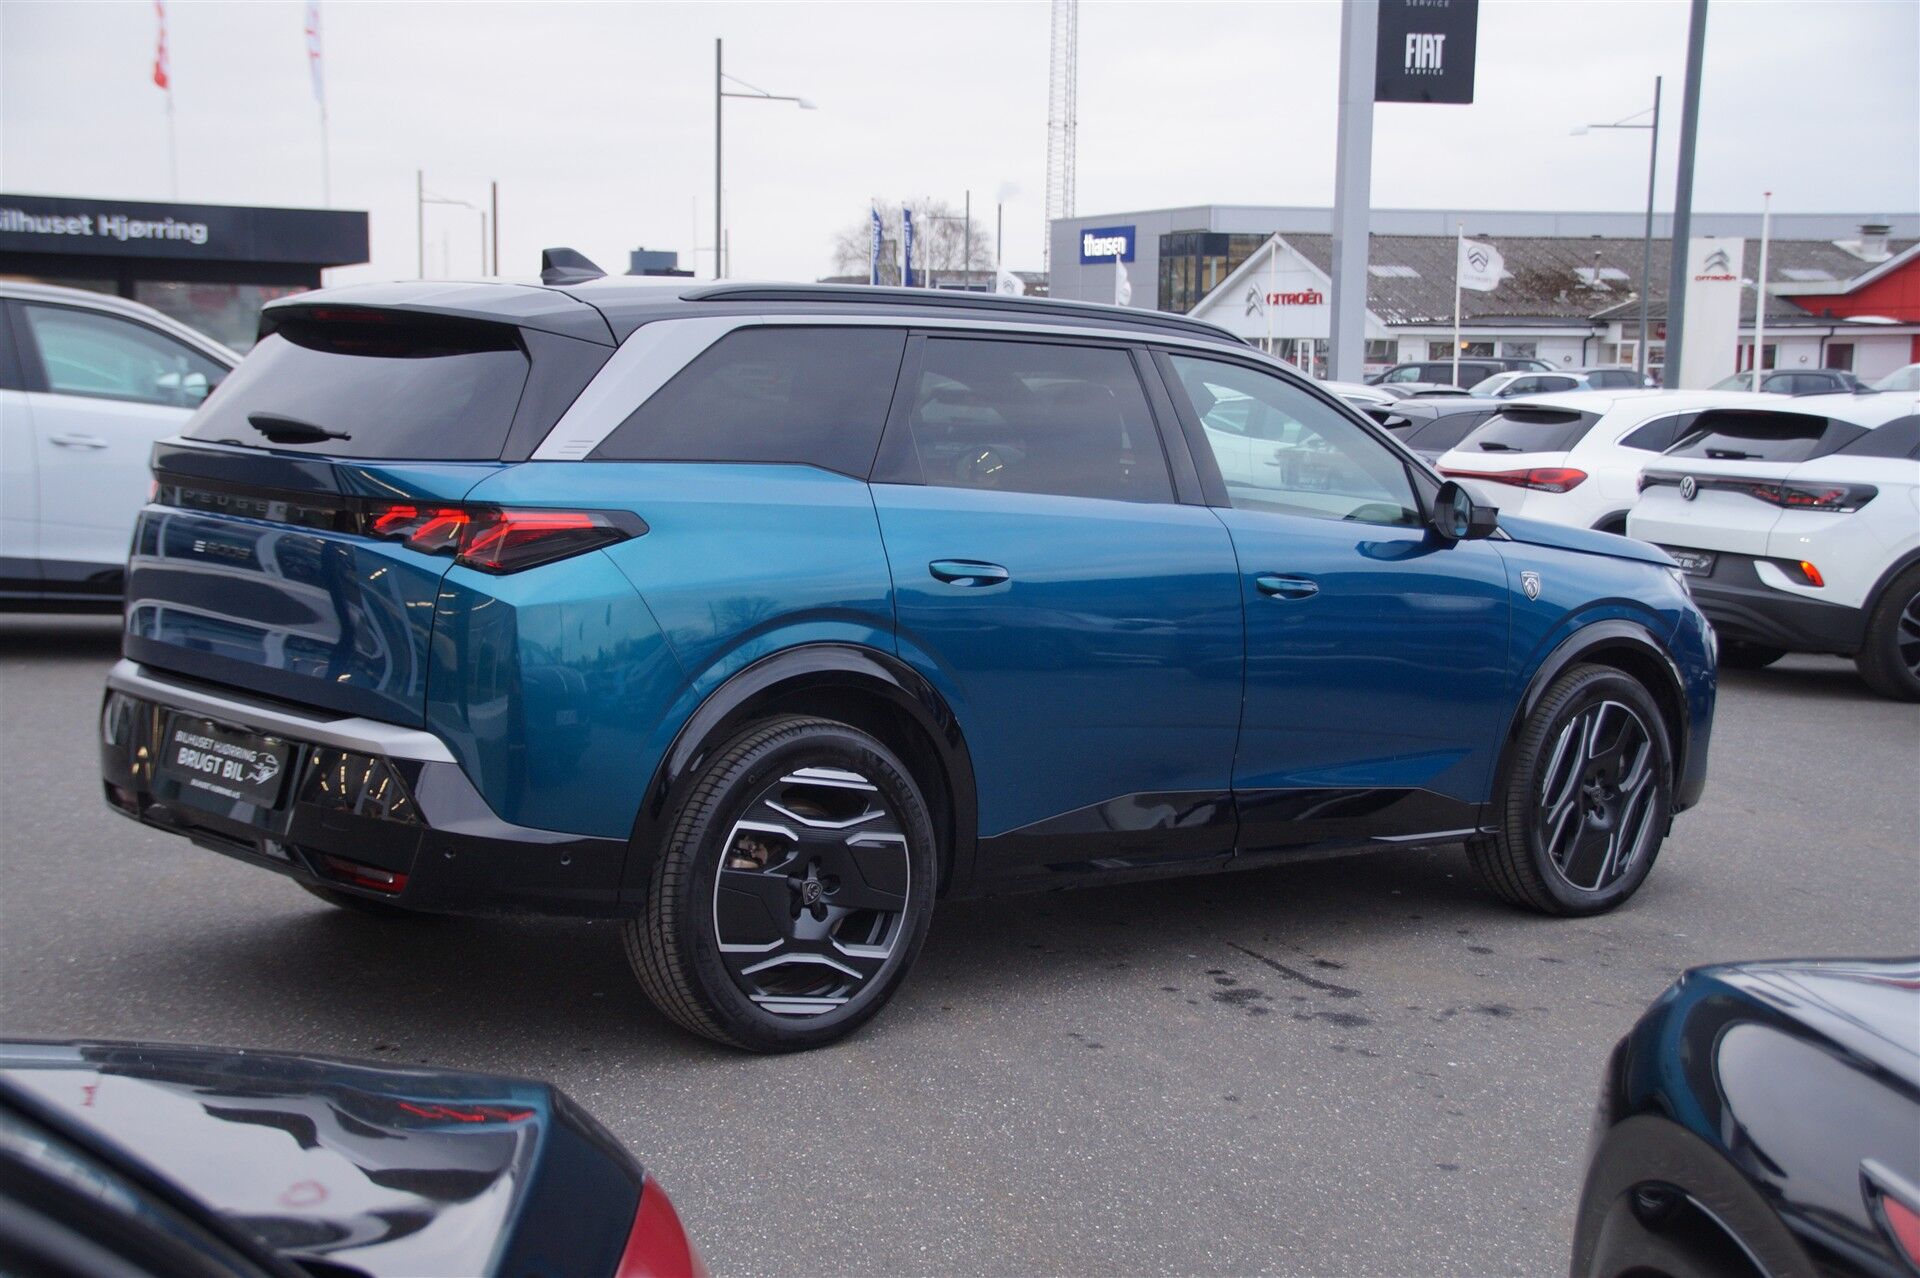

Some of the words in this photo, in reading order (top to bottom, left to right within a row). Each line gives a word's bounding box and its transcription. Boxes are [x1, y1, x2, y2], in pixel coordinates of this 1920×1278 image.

[1405, 33, 1446, 69] FIAT
[97, 214, 208, 244] Hjørring
[1083, 233, 1126, 257] thansen
[177, 747, 224, 775] BRUGT
[221, 759, 244, 783] BIL
